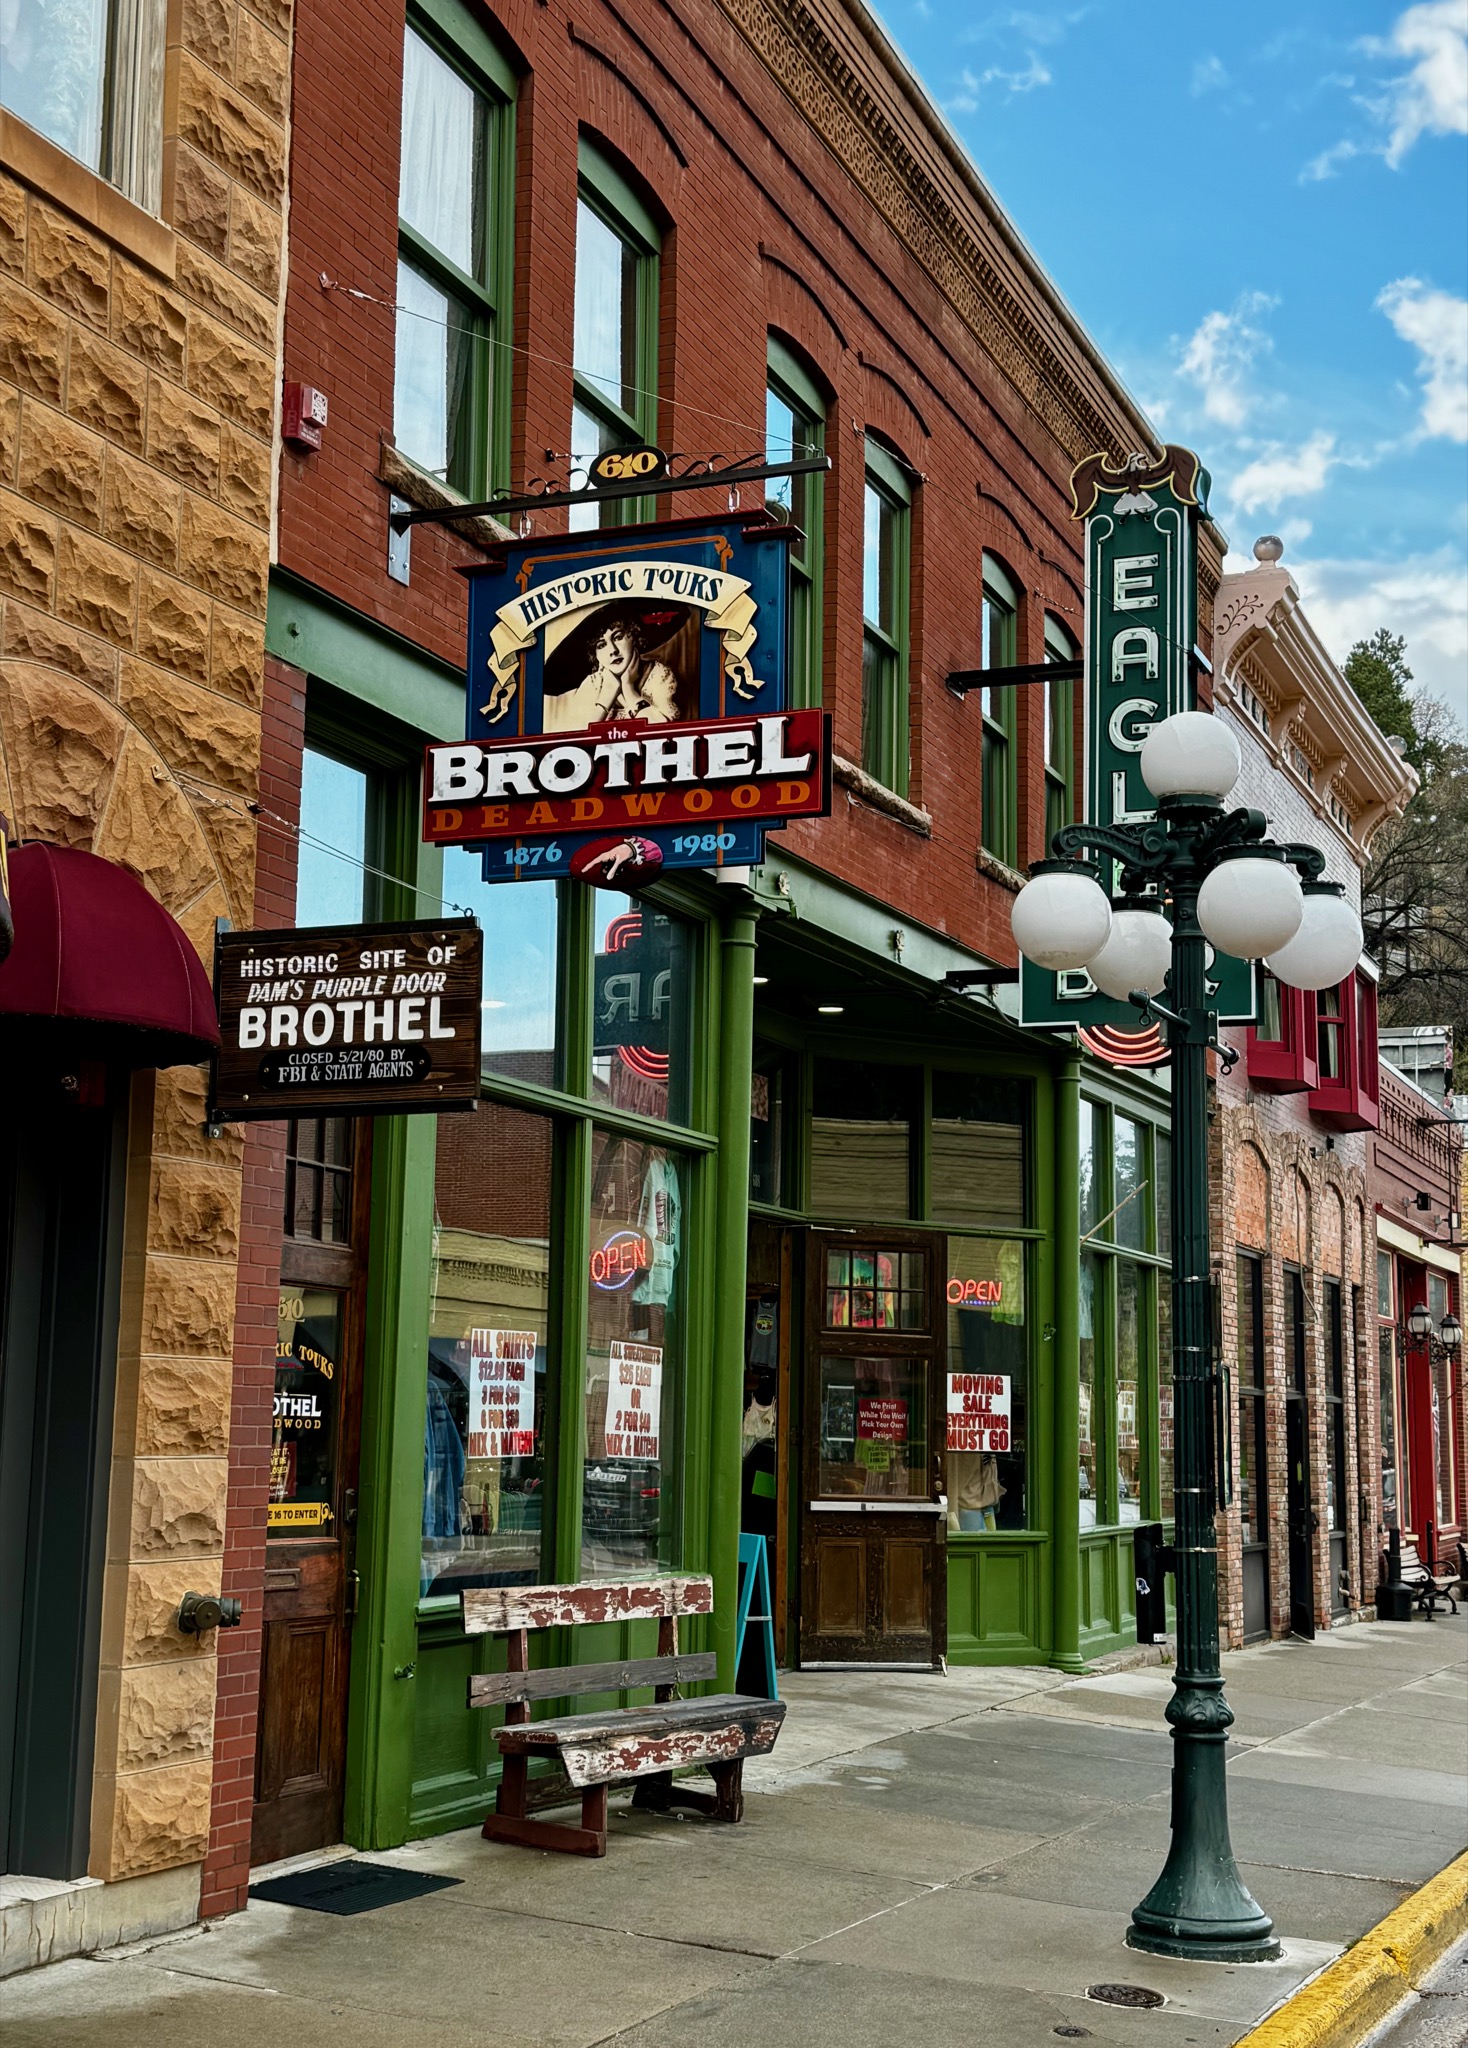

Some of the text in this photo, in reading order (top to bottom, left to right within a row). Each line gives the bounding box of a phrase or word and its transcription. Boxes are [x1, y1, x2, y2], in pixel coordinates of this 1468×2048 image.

[597, 452, 659, 479] 610
[518, 568, 724, 627] HISTORIC TOURS
[607, 727, 629, 740] the
[428, 716, 812, 802] BROTHEL
[432, 781, 811, 832] DEADWOOD
[503, 841, 563, 866] 1876
[671, 832, 737, 857] 1980
[240, 945, 457, 978] HISTORIC SITE OF
[246, 971, 447, 1003] PAM'S PURPLE DOOR
[238, 996, 456, 1049] BROTHEL
[288, 1048, 406, 1065] CLOSED 5/21/80 BY
[278, 1060, 414, 1083] FBI & STATE AGENTS
[591, 1237, 647, 1282] OPEN
[947, 1278, 1003, 1304] OPEN
[278, 1296, 304, 1321] 610
[471, 1330, 535, 1360] ALL SHIRTS
[611, 1342, 623, 1360] ALL
[299, 1345, 334, 1380] TOURS
[506, 1361, 526, 1381] EACH
[635, 1365, 652, 1387] EACH
[951, 1375, 1004, 1396] MOVING
[488, 1385, 505, 1405] FOR
[631, 1388, 642, 1409] OR
[870, 1402, 897, 1410] We Print
[962, 1395, 993, 1414] SALE
[488, 1409, 505, 1429] FOR
[615, 1410, 622, 1431] 2
[623, 1411, 638, 1432] FOR
[876, 1421, 889, 1429] Your
[880, 1411, 891, 1420] You
[892, 1412, 906, 1420] Wait
[947, 1412, 1009, 1430] EVERYTHING
[469, 1431, 533, 1457] MIX & MATCH
[606, 1433, 657, 1459] MIX & MATCH
[872, 1431, 893, 1441] Design
[947, 1429, 1010, 1451] MUST GO
[274, 1510, 282, 1520] 16
[283, 1510, 293, 1519] TO
[295, 1509, 319, 1519] ENTER
